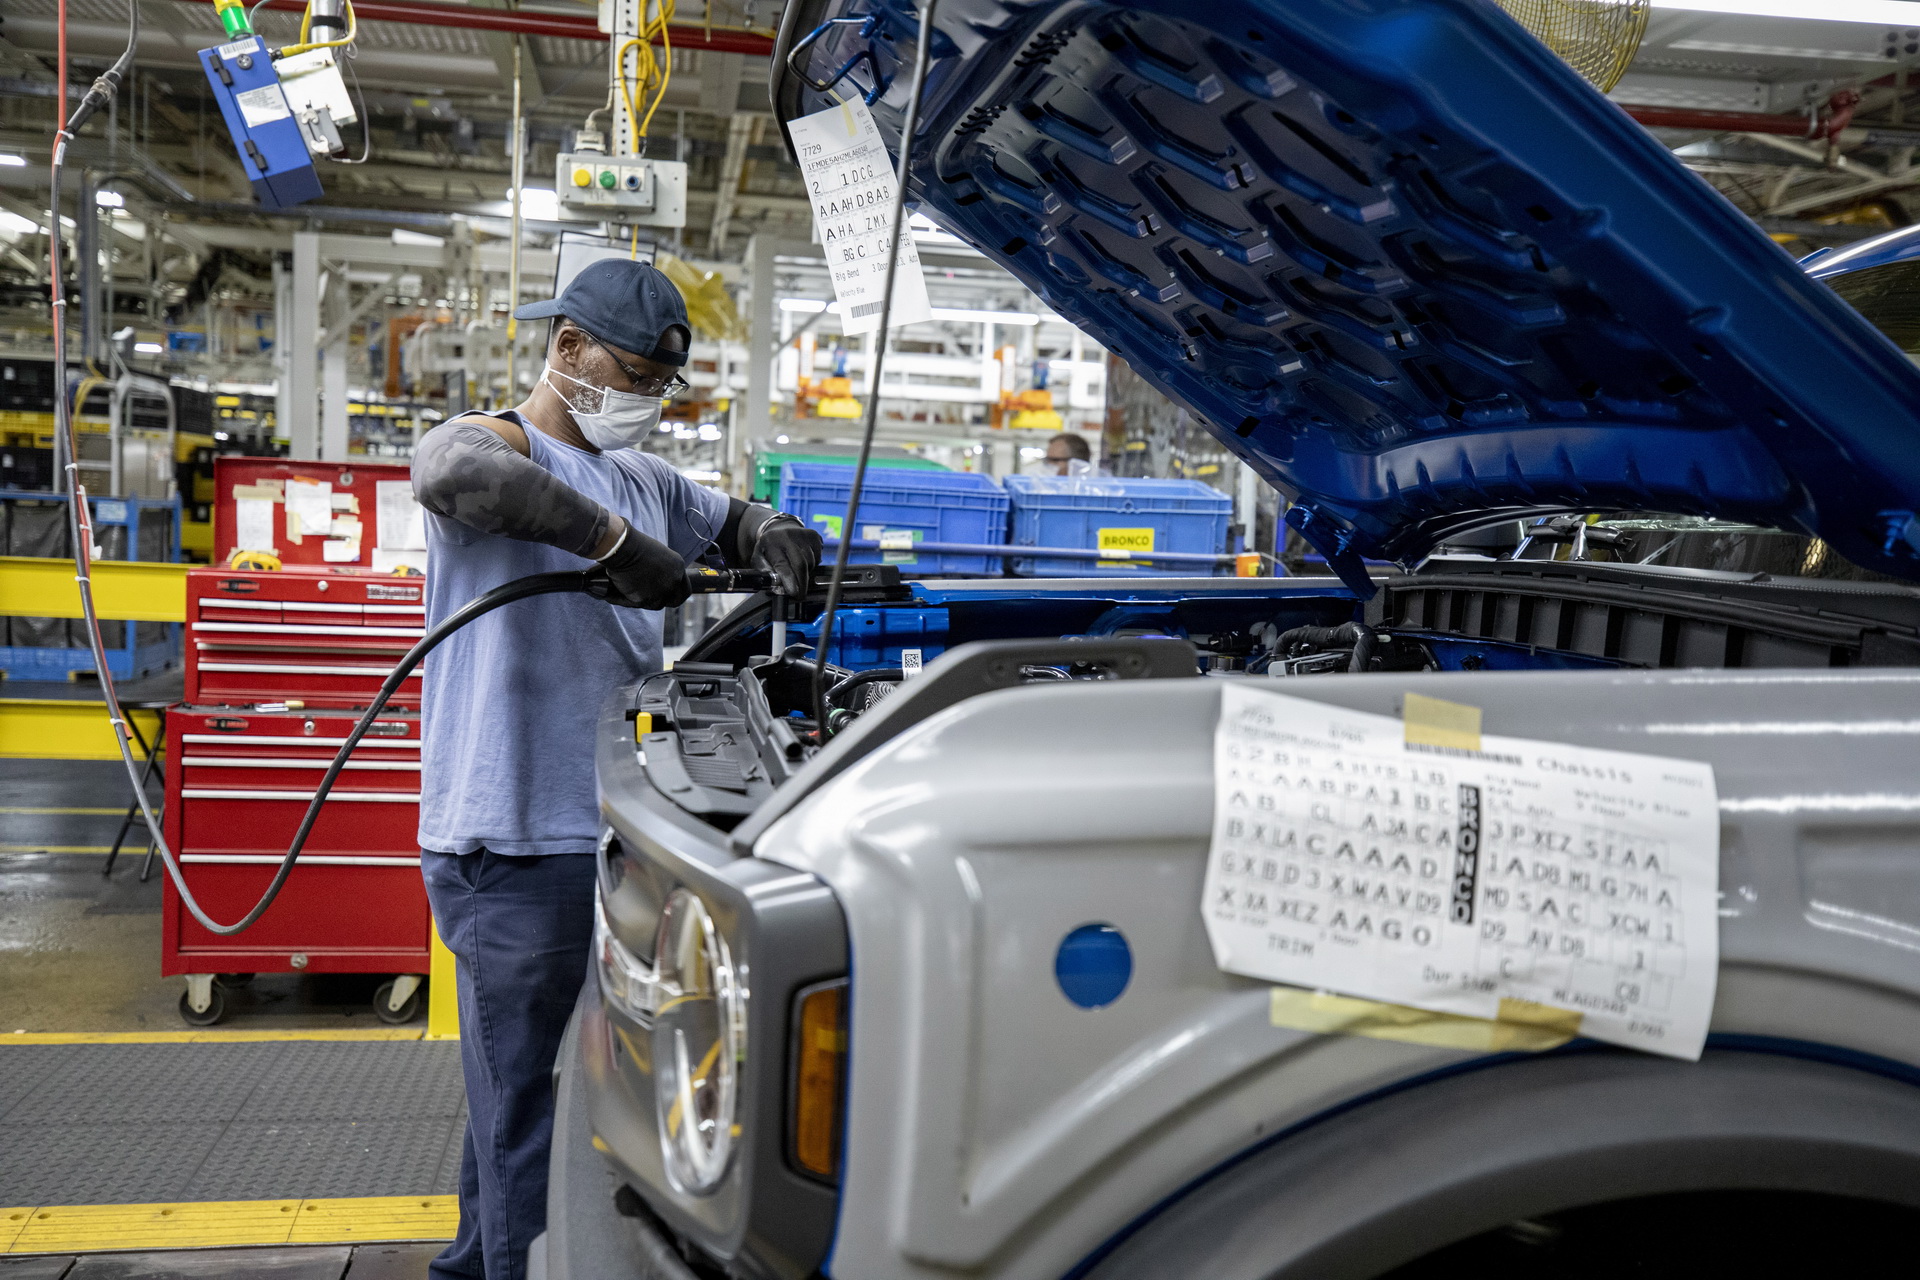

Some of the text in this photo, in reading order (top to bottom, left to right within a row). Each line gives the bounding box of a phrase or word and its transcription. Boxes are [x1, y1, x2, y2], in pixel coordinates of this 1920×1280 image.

[802, 144, 822, 157] 7729
[812, 164, 874, 194] 2 1 D C G
[820, 185, 890, 218] A A AH D 8 A B
[826, 213, 888, 241] A H A Z M X
[843, 247, 855, 261] BG
[857, 245, 866, 257] C
[878, 239, 885, 252] C
[835, 272, 846, 281] Big
[846, 268, 860, 279] Bend
[872, 263, 876, 272] 3
[876, 262, 889, 272] Door
[1104, 536, 1150, 546] BRONCO
[1537, 757, 1633, 783] Chassis
[1365, 784, 1380, 801] A
[1228, 789, 1250, 808] A
[1257, 793, 1276, 811] B
[1361, 812, 1379, 835] A
[1415, 823, 1431, 844] C
[1435, 827, 1452, 848] A
[1226, 817, 1245, 838] B
[1251, 822, 1267, 843] X
[1305, 832, 1327, 855] C
[1333, 840, 1357, 860] A
[1363, 847, 1384, 868] A
[1389, 852, 1412, 875] A
[1419, 857, 1438, 879] D
[1452, 785, 1478, 924] BRONCO
[1584, 839, 1599, 860] S
[1621, 849, 1638, 869] A
[1642, 852, 1661, 874] A
[1241, 854, 1257, 876] X
[1261, 858, 1279, 881] B
[1282, 863, 1300, 885] D
[1304, 866, 1321, 889] 3
[1329, 873, 1345, 894] X
[1351, 878, 1369, 899] W
[1373, 882, 1390, 903] A
[1504, 856, 1525, 877] A
[1600, 877, 1618, 897] G
[1656, 888, 1675, 909] A
[1216, 885, 1236, 906] X
[1329, 909, 1348, 930] A
[1354, 914, 1374, 935] A
[1381, 918, 1402, 941] G
[1538, 896, 1560, 918] A
[1567, 902, 1582, 924] C
[1500, 956, 1514, 979] C
